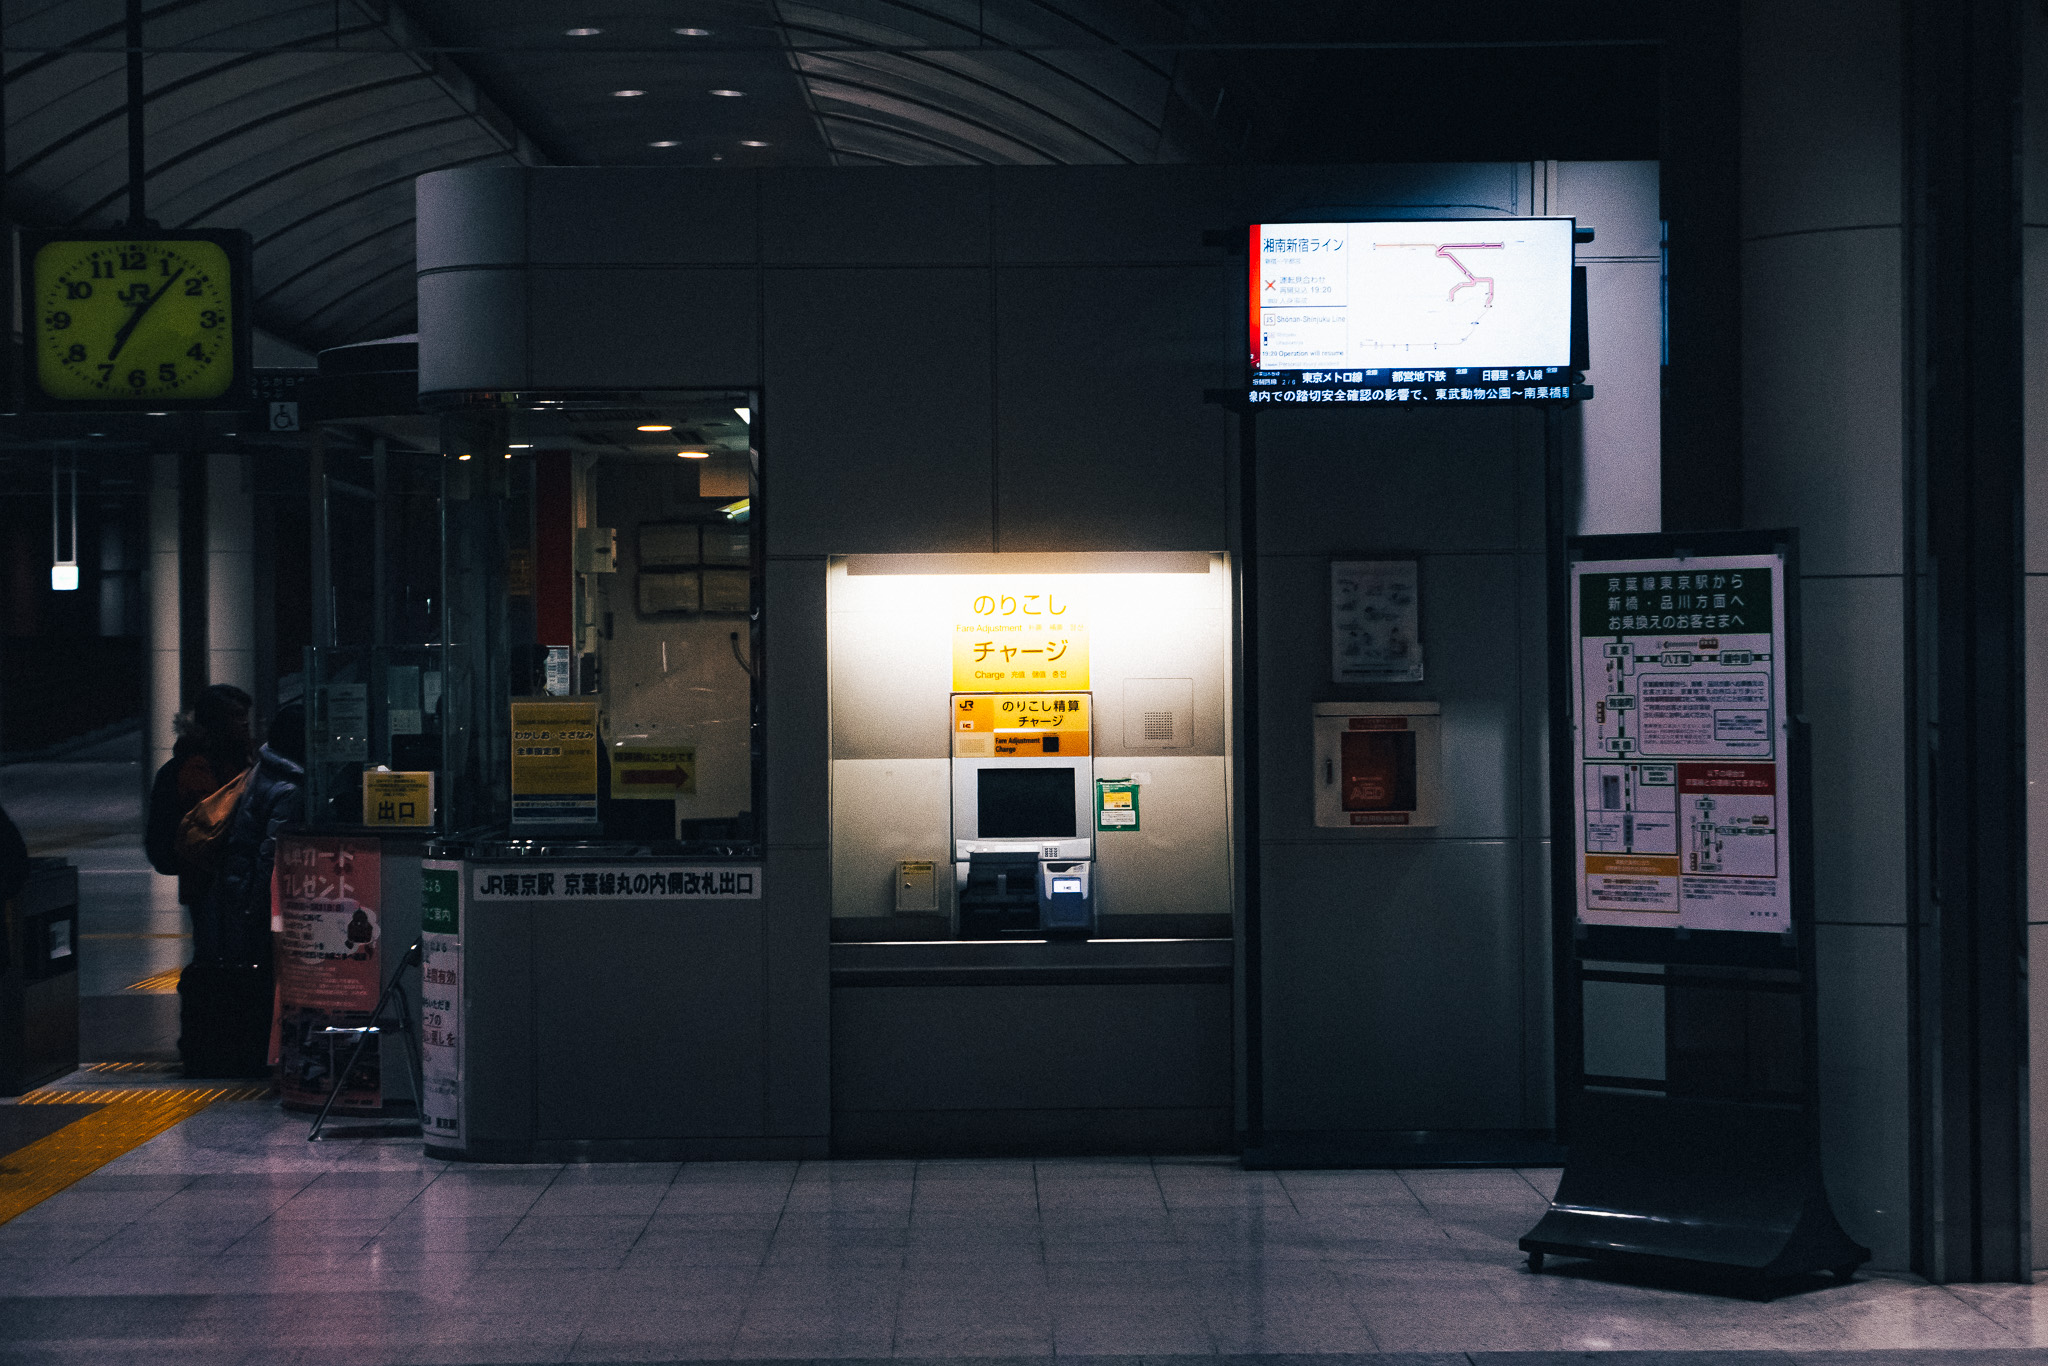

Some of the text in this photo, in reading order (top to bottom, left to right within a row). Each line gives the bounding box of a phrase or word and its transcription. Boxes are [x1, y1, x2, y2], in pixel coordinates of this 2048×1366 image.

[1263, 238, 1344, 253] 湘南新宿ライン
[91, 260, 115, 279] 11
[119, 252, 146, 270] 12
[160, 258, 171, 277] 1
[66, 281, 93, 300] 10
[118, 284, 151, 301] JR
[184, 278, 202, 296] 2
[53, 311, 71, 330] 9
[200, 310, 217, 328] 3
[68, 344, 87, 362] 8
[186, 343, 205, 360] 4
[1279, 350, 1309, 358] Operation
[97, 364, 115, 382] 7
[128, 369, 147, 388] 6
[159, 363, 176, 381] 5
[1302, 371, 1363, 383] 東京メトロ線
[1392, 370, 1446, 382] 都営地下鉄
[1482, 369, 1543, 381] 日暮里・舎人線
[1608, 574, 1744, 592] 京葉線東京駅から
[973, 594, 1067, 616] のりこし
[1608, 593, 1745, 611] 新橋・品川方面へ
[956, 624, 975, 633] Fare
[976, 624, 1022, 634] Adjustment
[1608, 614, 1745, 631] お乗換えのお客さまへ
[973, 639, 1068, 663] チャージ
[974, 670, 1005, 680] Charge
[959, 701, 974, 709] JR
[1002, 700, 1080, 712] のりこし精算
[1018, 715, 1064, 727] チャージ
[515, 730, 594, 740] わかしお・さざなみ
[1008, 737, 1041, 745] Adjustment
[995, 746, 1016, 754] Charge
[378, 800, 415, 819] 出口
[480, 872, 753, 896] JR東京駅 京葉線丸の内側改札出口
